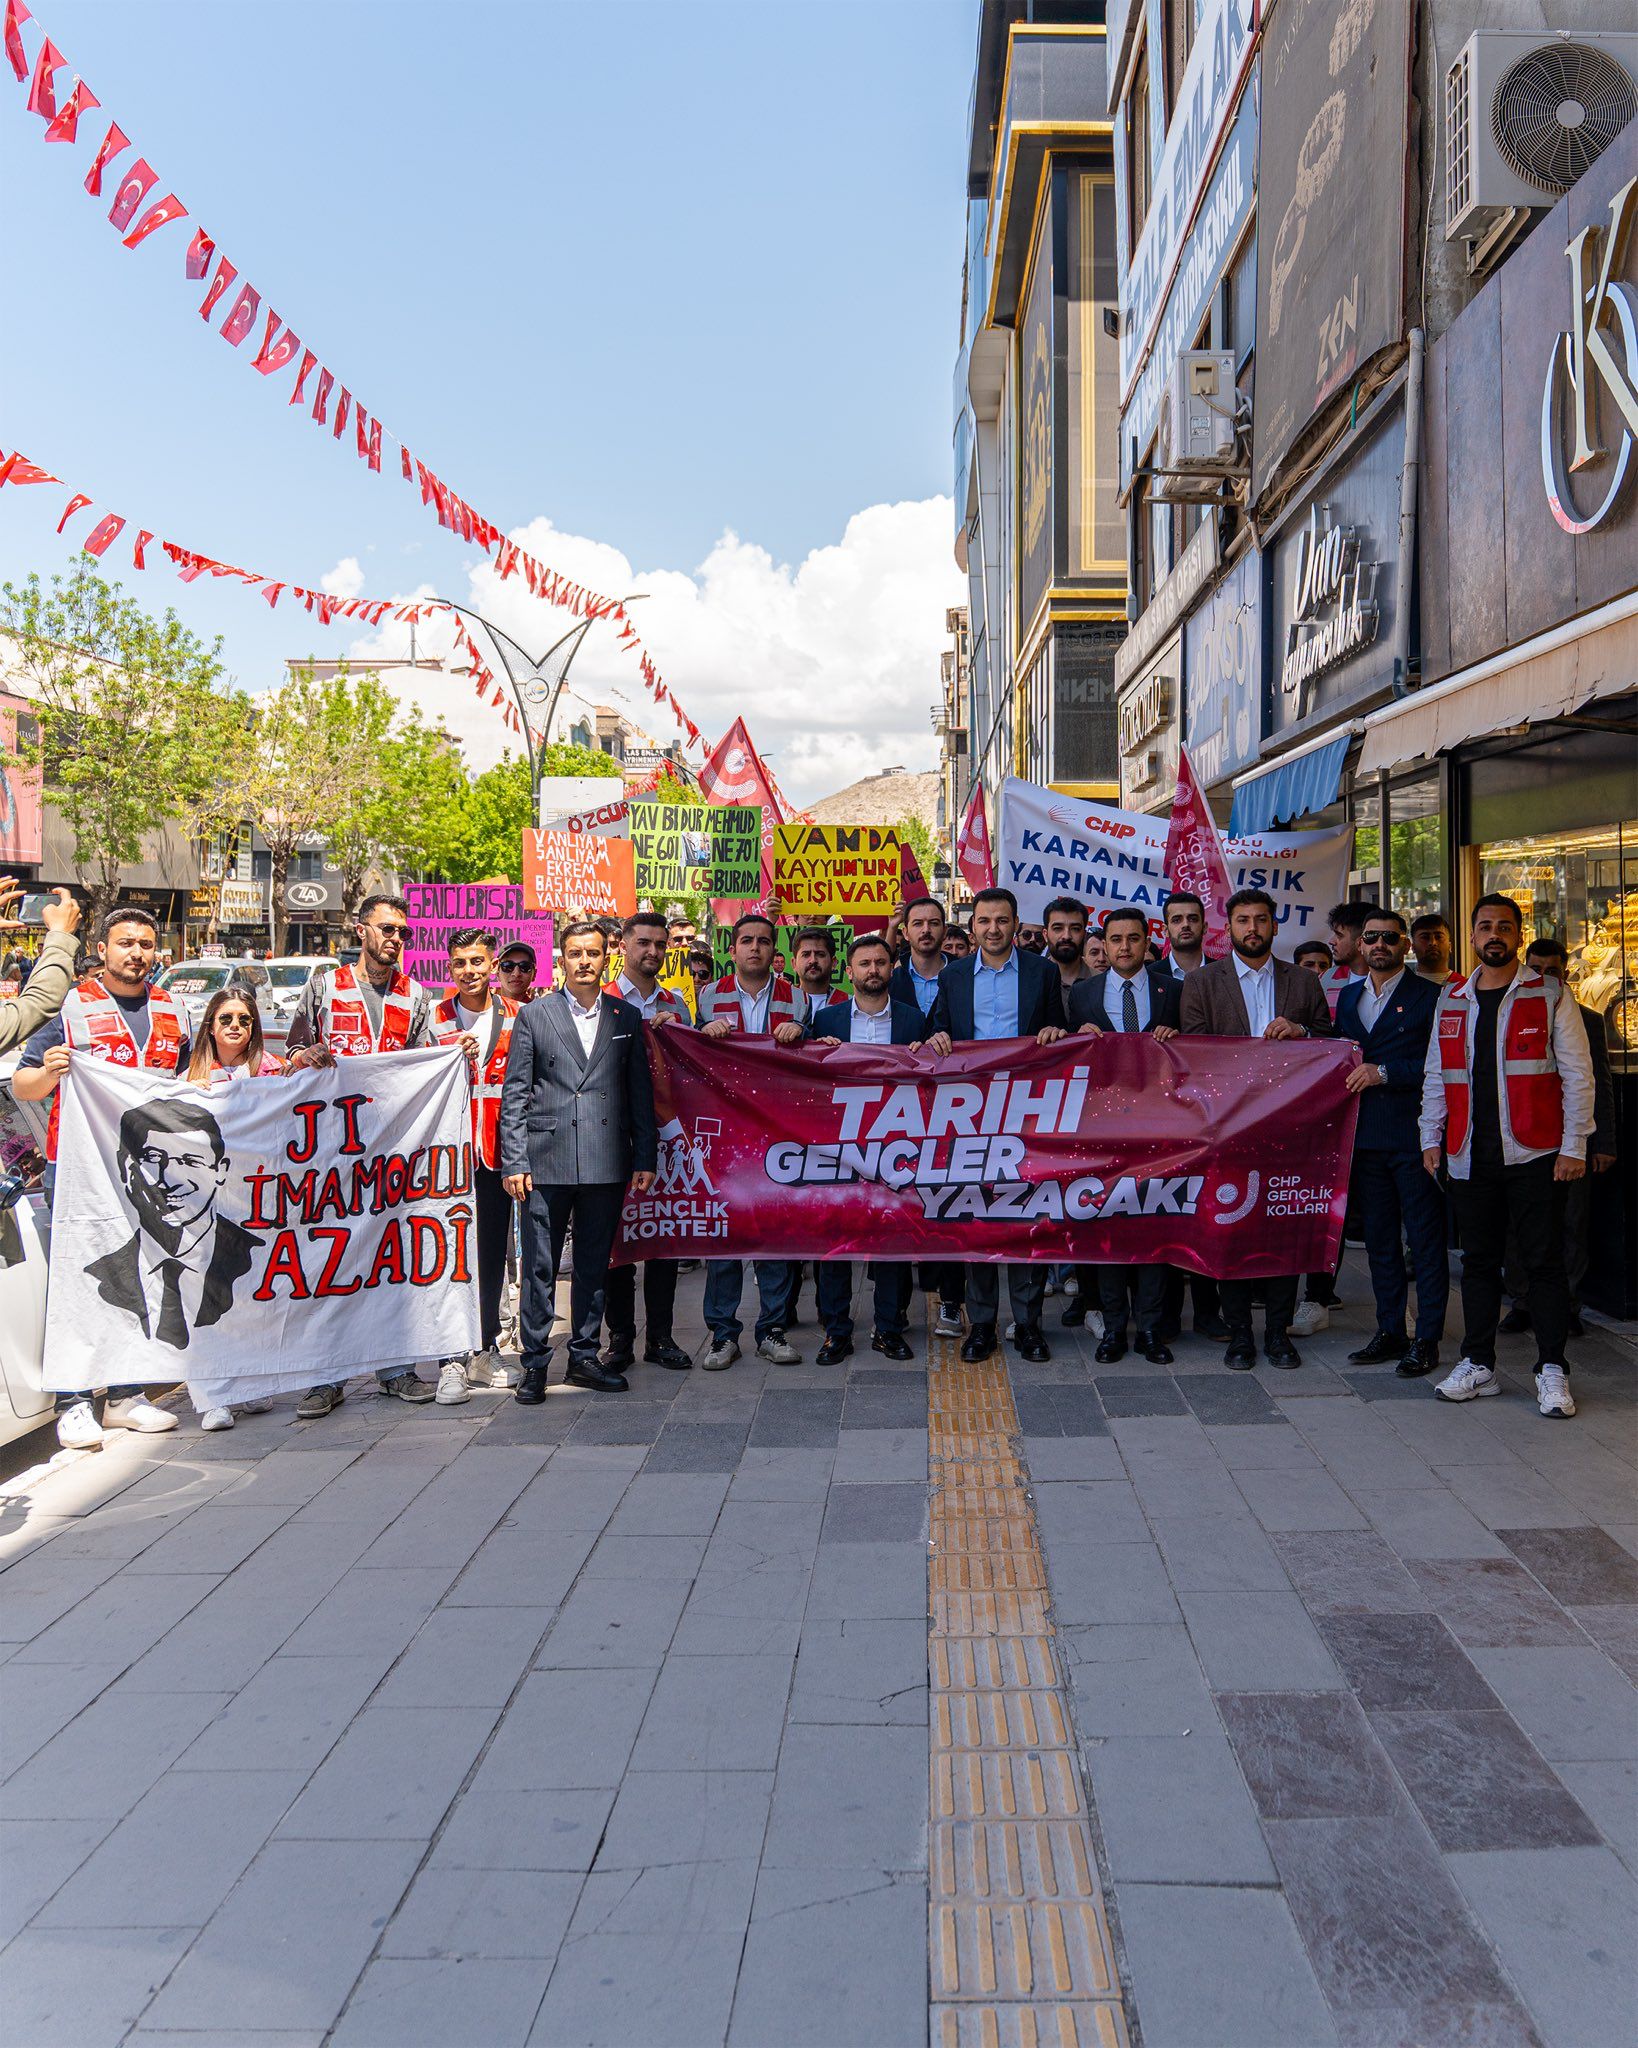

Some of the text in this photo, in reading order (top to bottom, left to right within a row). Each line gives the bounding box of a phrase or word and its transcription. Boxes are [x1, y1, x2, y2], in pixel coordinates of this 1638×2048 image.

[630, 804, 658, 831] YAV
[662, 805, 680, 831] Bİ
[681, 807, 704, 832] DUR
[704, 808, 755, 834] MEHMUD
[1085, 816, 1136, 840] CHP
[533, 829, 608, 852] VANLIYAM
[630, 833, 655, 860] NE
[712, 837, 733, 862] NE
[536, 843, 611, 866] ŞANLIYAM
[547, 860, 597, 879] EKREM
[636, 861, 760, 893] BÜTÜN 65 BURADA
[775, 858, 898, 880] KAYYUM'UN
[1237, 867, 1306, 893] IŞIK
[535, 874, 612, 897] BAŞKANIN
[775, 883, 804, 904] NE
[836, 877, 901, 907] VAR?
[832, 1066, 1090, 1140] TARİHİ
[764, 1136, 1026, 1192] GENÇLER
[1268, 1176, 1301, 1187] CHP
[916, 1175, 1205, 1221] YAZACAK!
[1267, 1188, 1333, 1203] GENÇLİK
[622, 1200, 729, 1222] GENÇLİK
[1266, 1203, 1329, 1216] KOLLARI
[623, 1219, 728, 1243] KORTEJİ
[252, 1203, 473, 1301] AZADÎ
